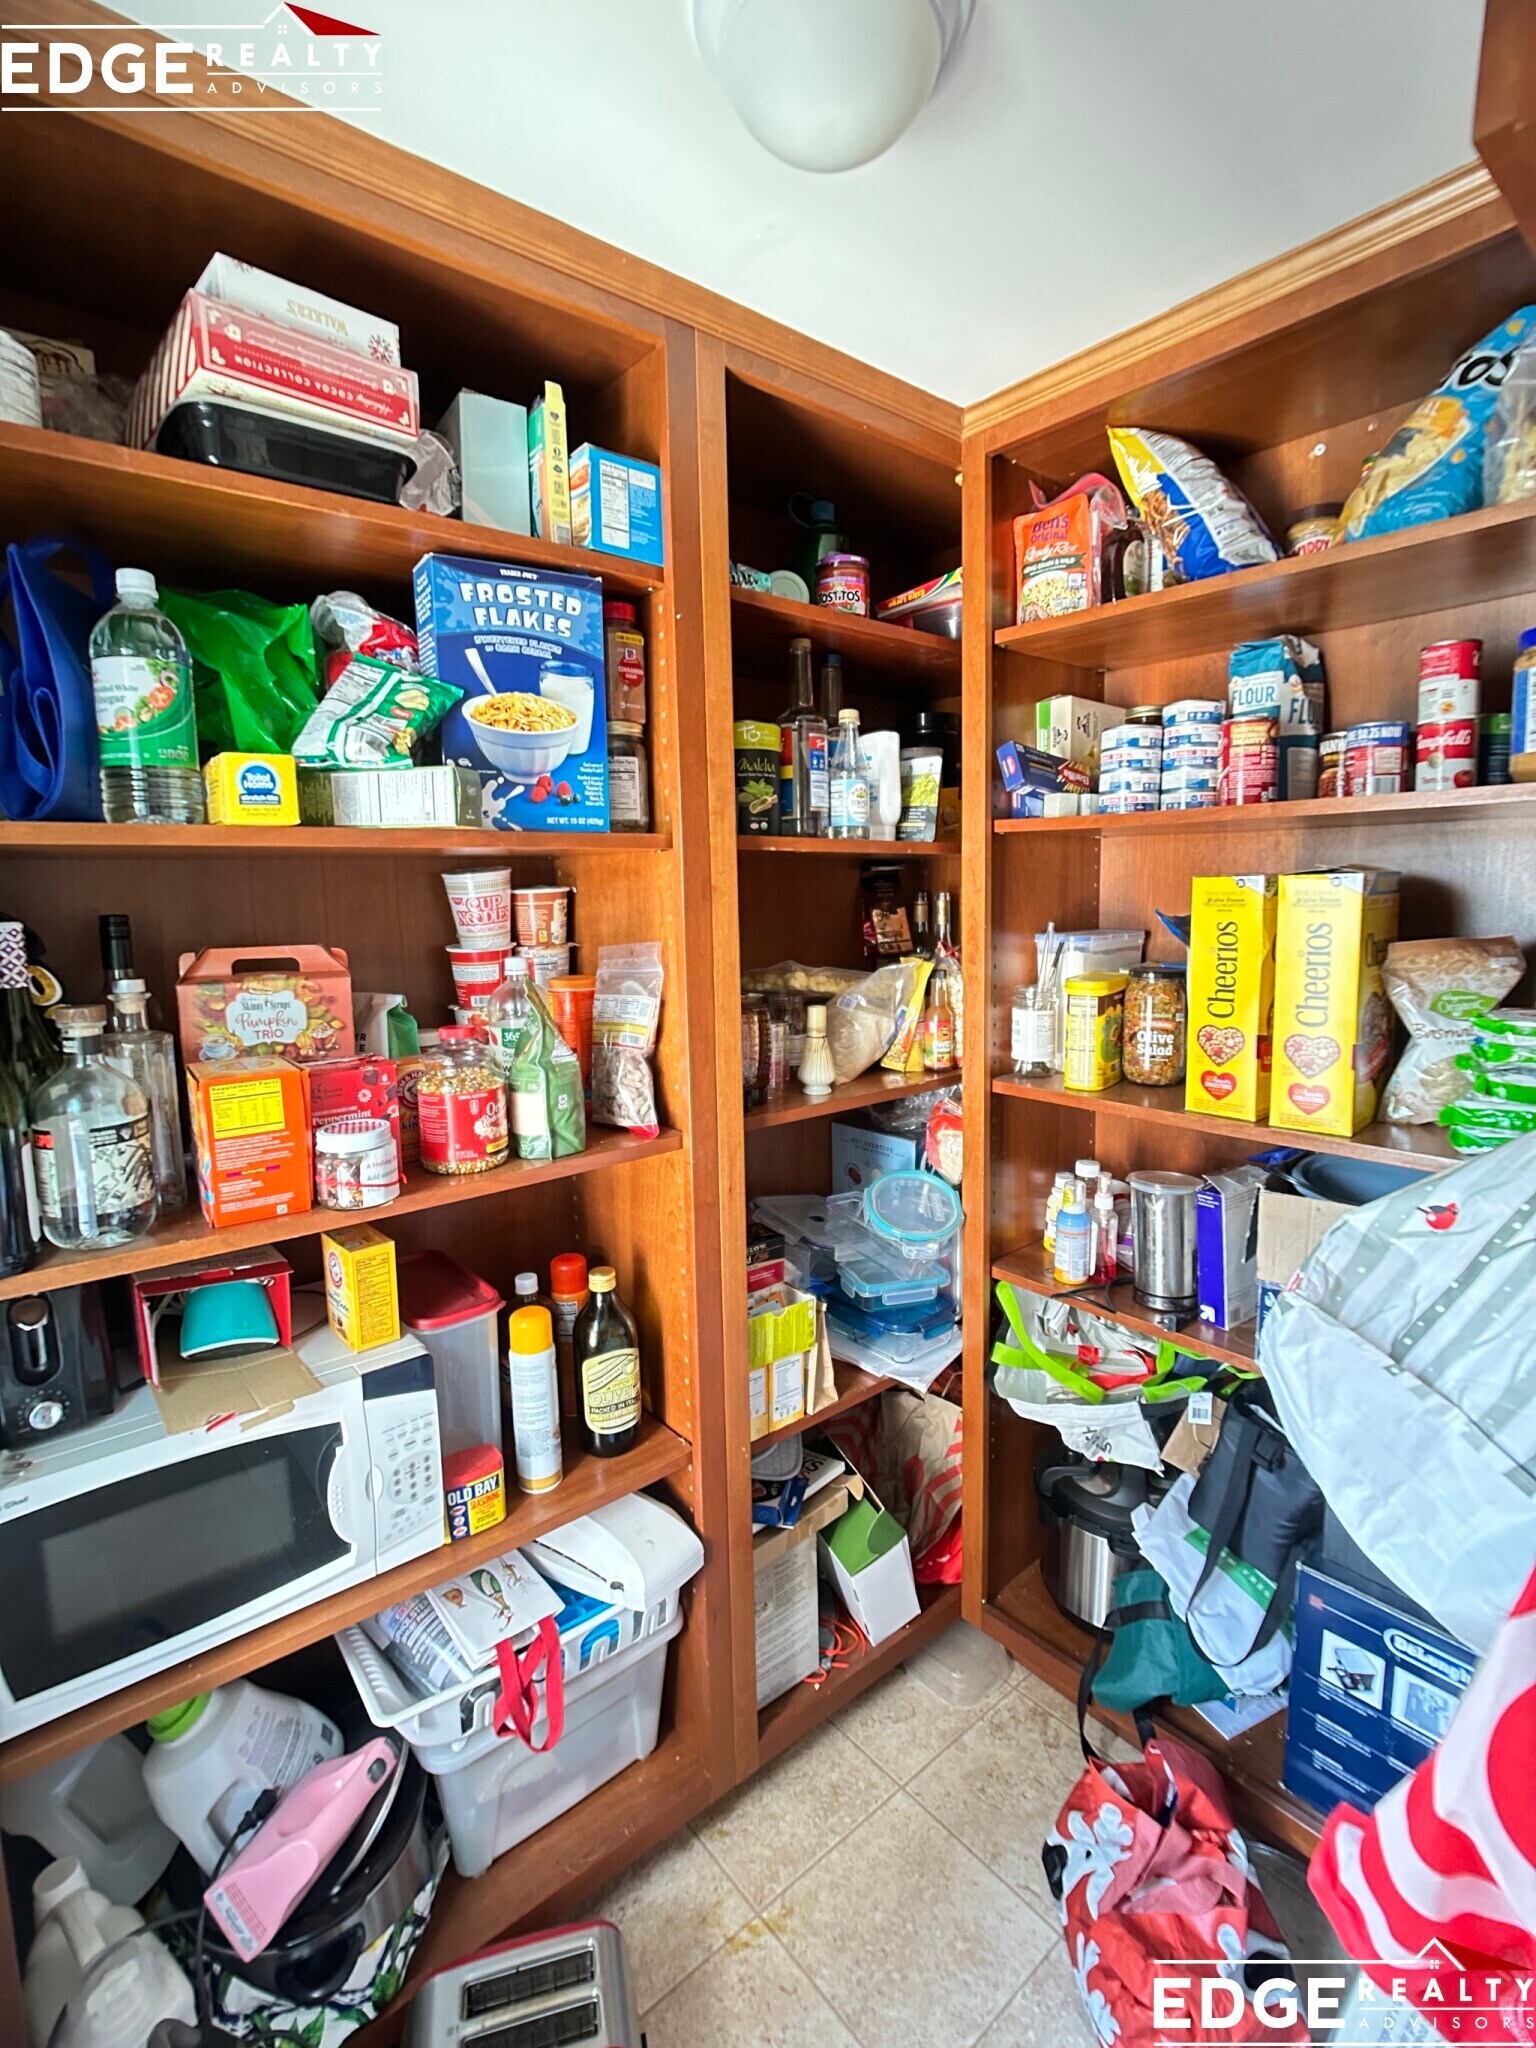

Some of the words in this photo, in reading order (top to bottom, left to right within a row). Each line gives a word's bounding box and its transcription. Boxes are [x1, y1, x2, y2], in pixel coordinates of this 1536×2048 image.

[234, 353, 311, 387] COLLECTION
[315, 381, 354, 401] COCOA
[1032, 512, 1070, 534] Ben's
[1030, 531, 1067, 544] Original
[1023, 543, 1054, 563] Ready
[1052, 541, 1080, 555] Rice
[459, 582, 582, 617] FROSTED
[819, 589, 861, 604] TOSTITOS
[473, 606, 572, 638] FLAKES
[1232, 686, 1276, 706] FLOUR
[736, 756, 776, 773] Matcha
[243, 780, 274, 790] Home
[244, 772, 271, 782] Total
[546, 816, 558, 825] NET
[570, 817, 578, 825] 15
[577, 817, 587, 825] OZ
[466, 894, 503, 911] CUP
[457, 907, 511, 926] NOODLES
[1206, 920, 1239, 1019] Cheerios
[1295, 921, 1334, 1029] Cheerios
[235, 1010, 298, 1031] Pumpkin
[253, 1028, 284, 1040] TRIO
[1136, 1030, 1175, 1044] Olive
[312, 1108, 372, 1126] Peppermint
[591, 1386, 633, 1406] OLIVE
[590, 1405, 617, 1414] PACKED
[617, 1402, 625, 1410] IN
[446, 1487, 473, 1507] OLD
[474, 1475, 498, 1498] BAY
[469, 1490, 501, 1510] SEASONING
